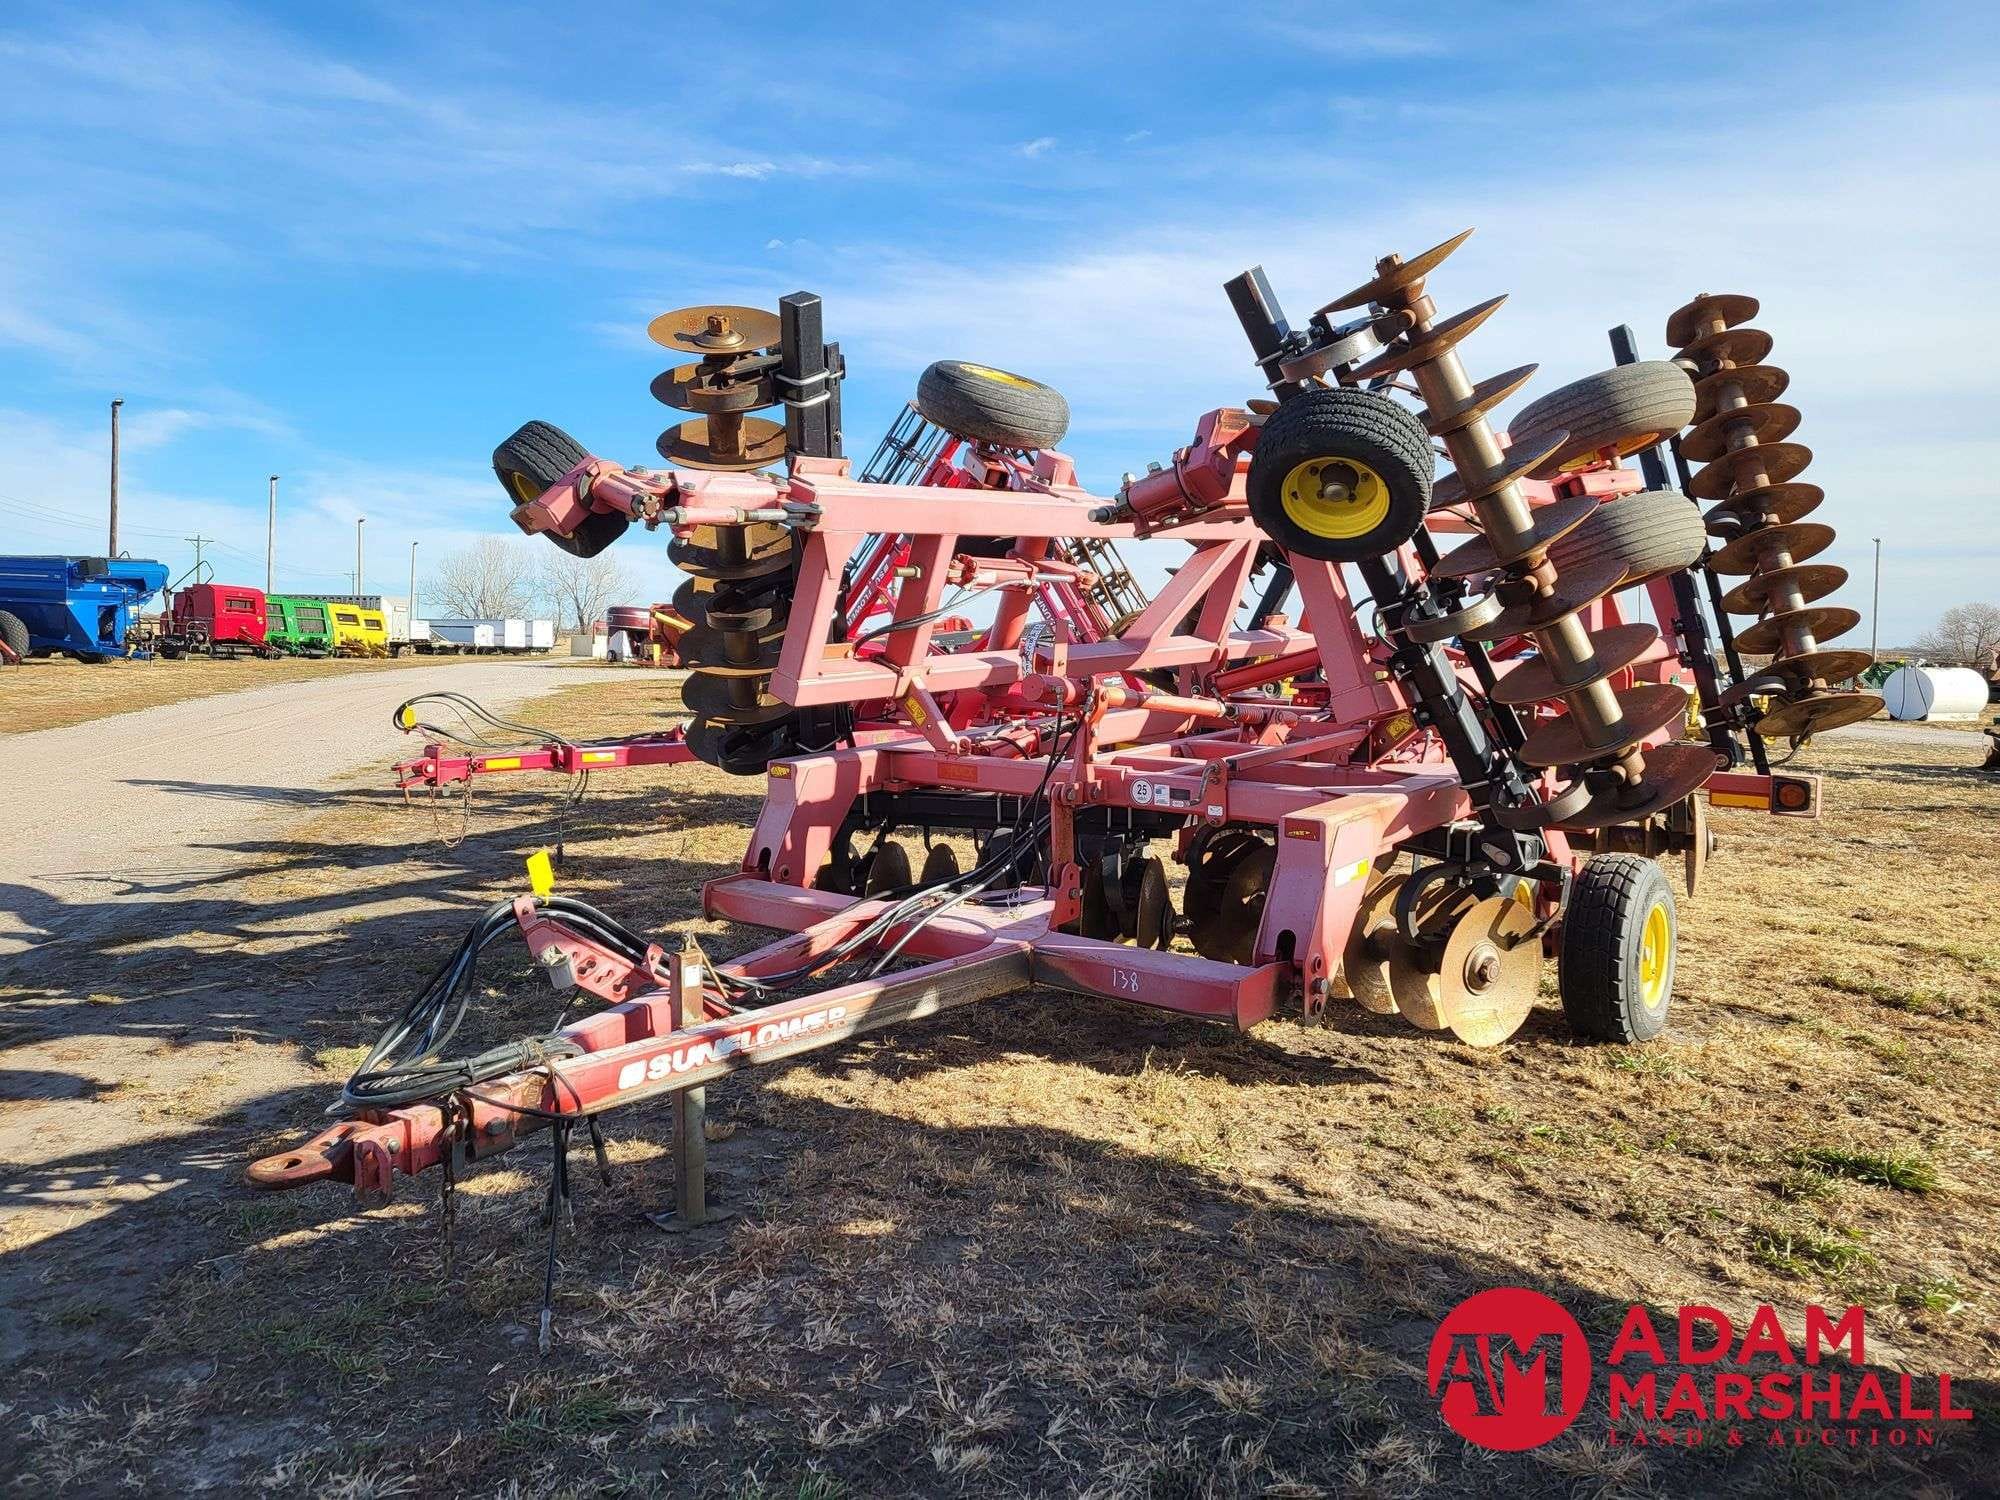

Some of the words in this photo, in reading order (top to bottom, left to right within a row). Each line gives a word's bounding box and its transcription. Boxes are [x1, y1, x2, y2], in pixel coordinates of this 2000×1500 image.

[846, 571, 887, 627] SUFLOWER
[1137, 784, 1148, 796] 25
[1113, 968, 1138, 992] 138
[646, 1006, 847, 1080] SUNFLOWER
